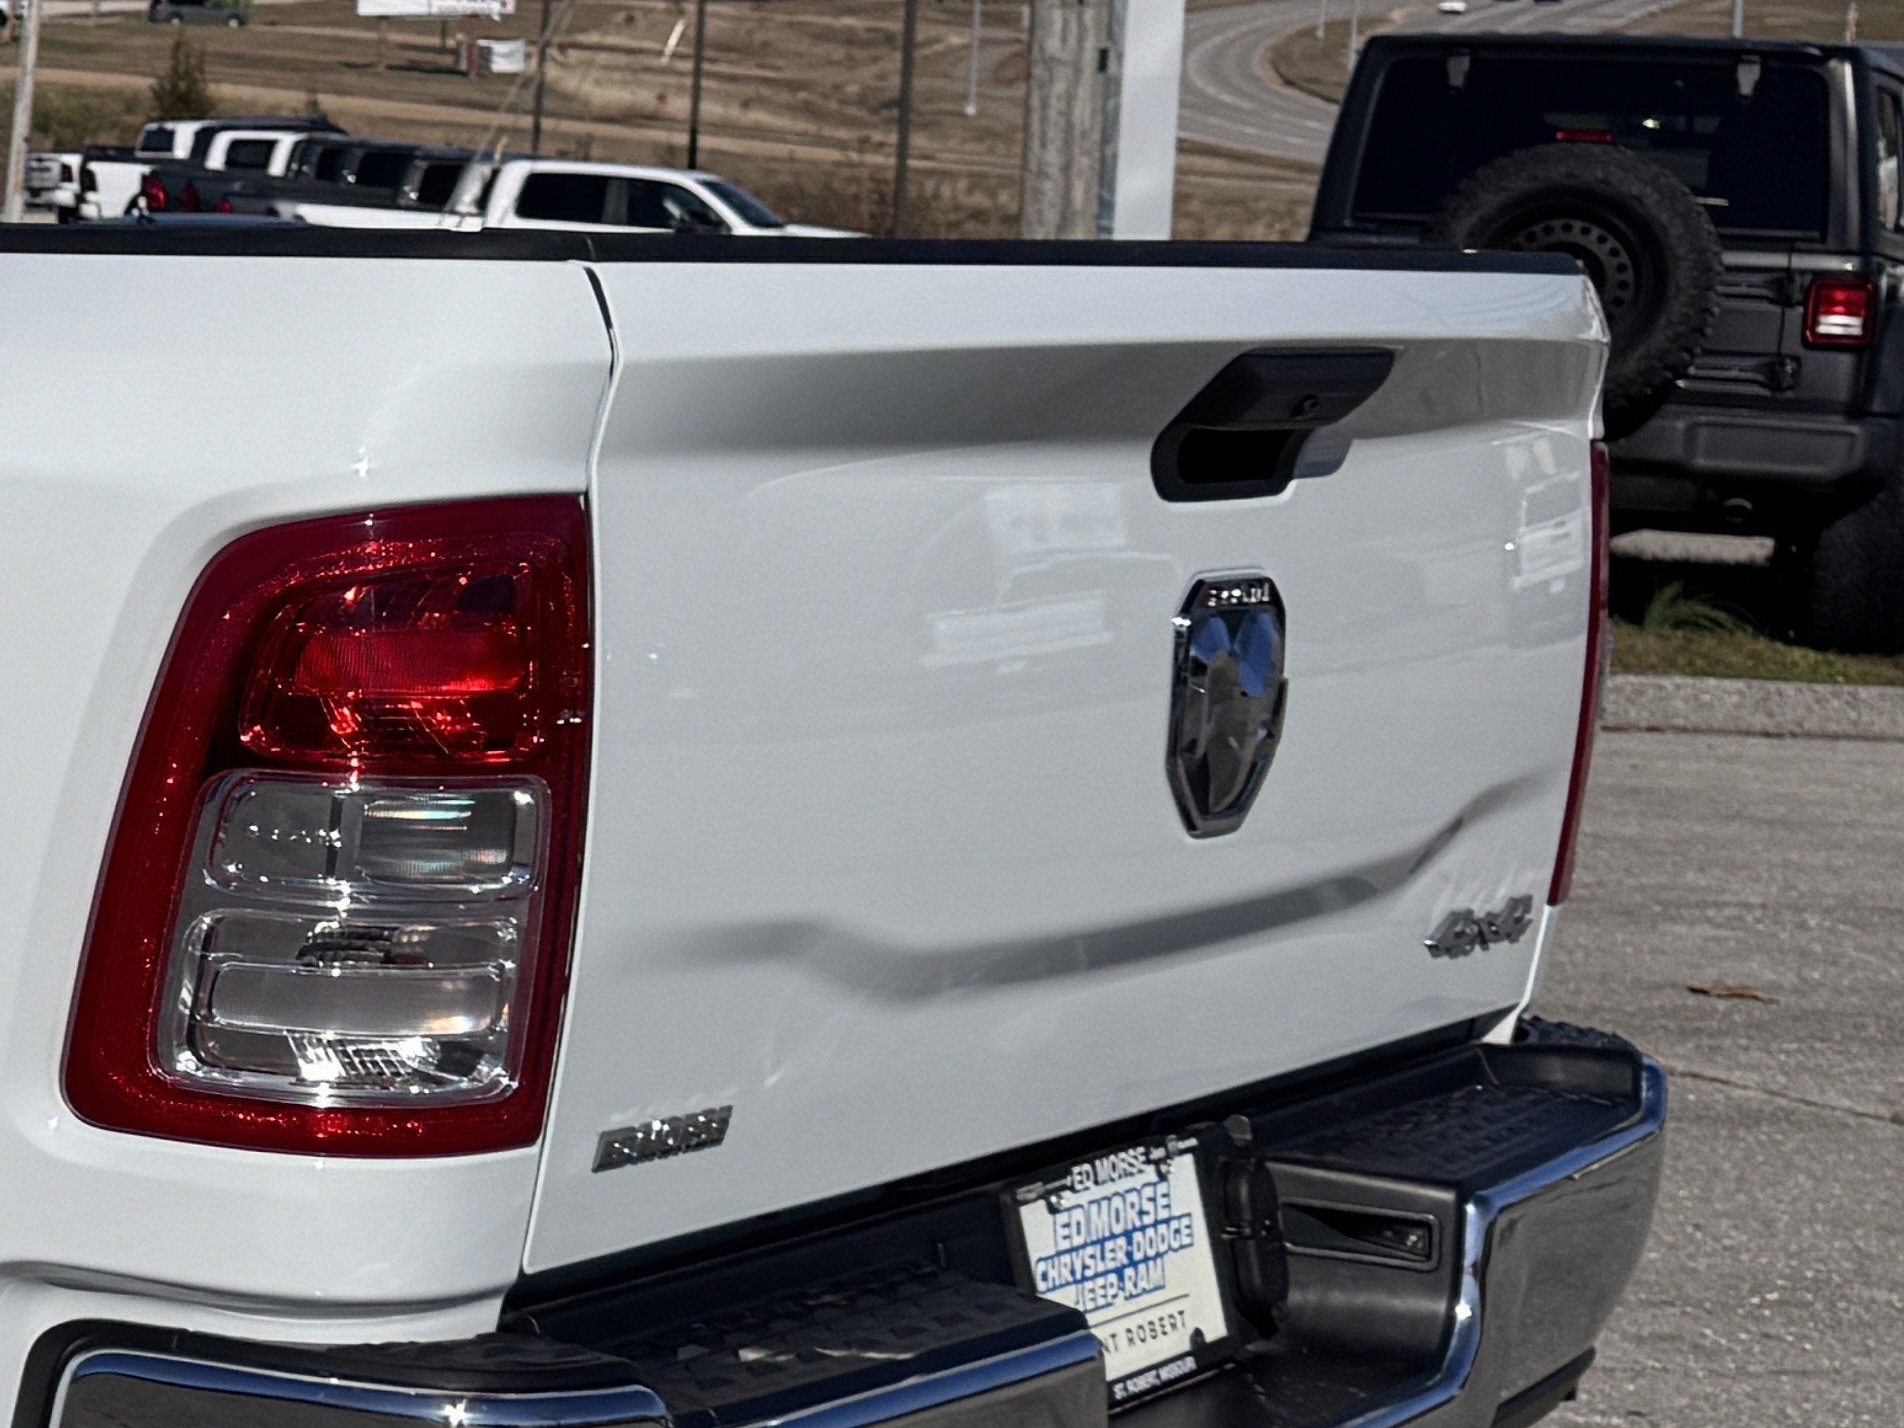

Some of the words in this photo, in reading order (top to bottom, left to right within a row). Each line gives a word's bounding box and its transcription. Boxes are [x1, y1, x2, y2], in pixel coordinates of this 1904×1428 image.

[1055, 1205, 1086, 1252] ED
[1088, 1182, 1171, 1242] MORSE
[1125, 1309, 1186, 1348] ROBERT
